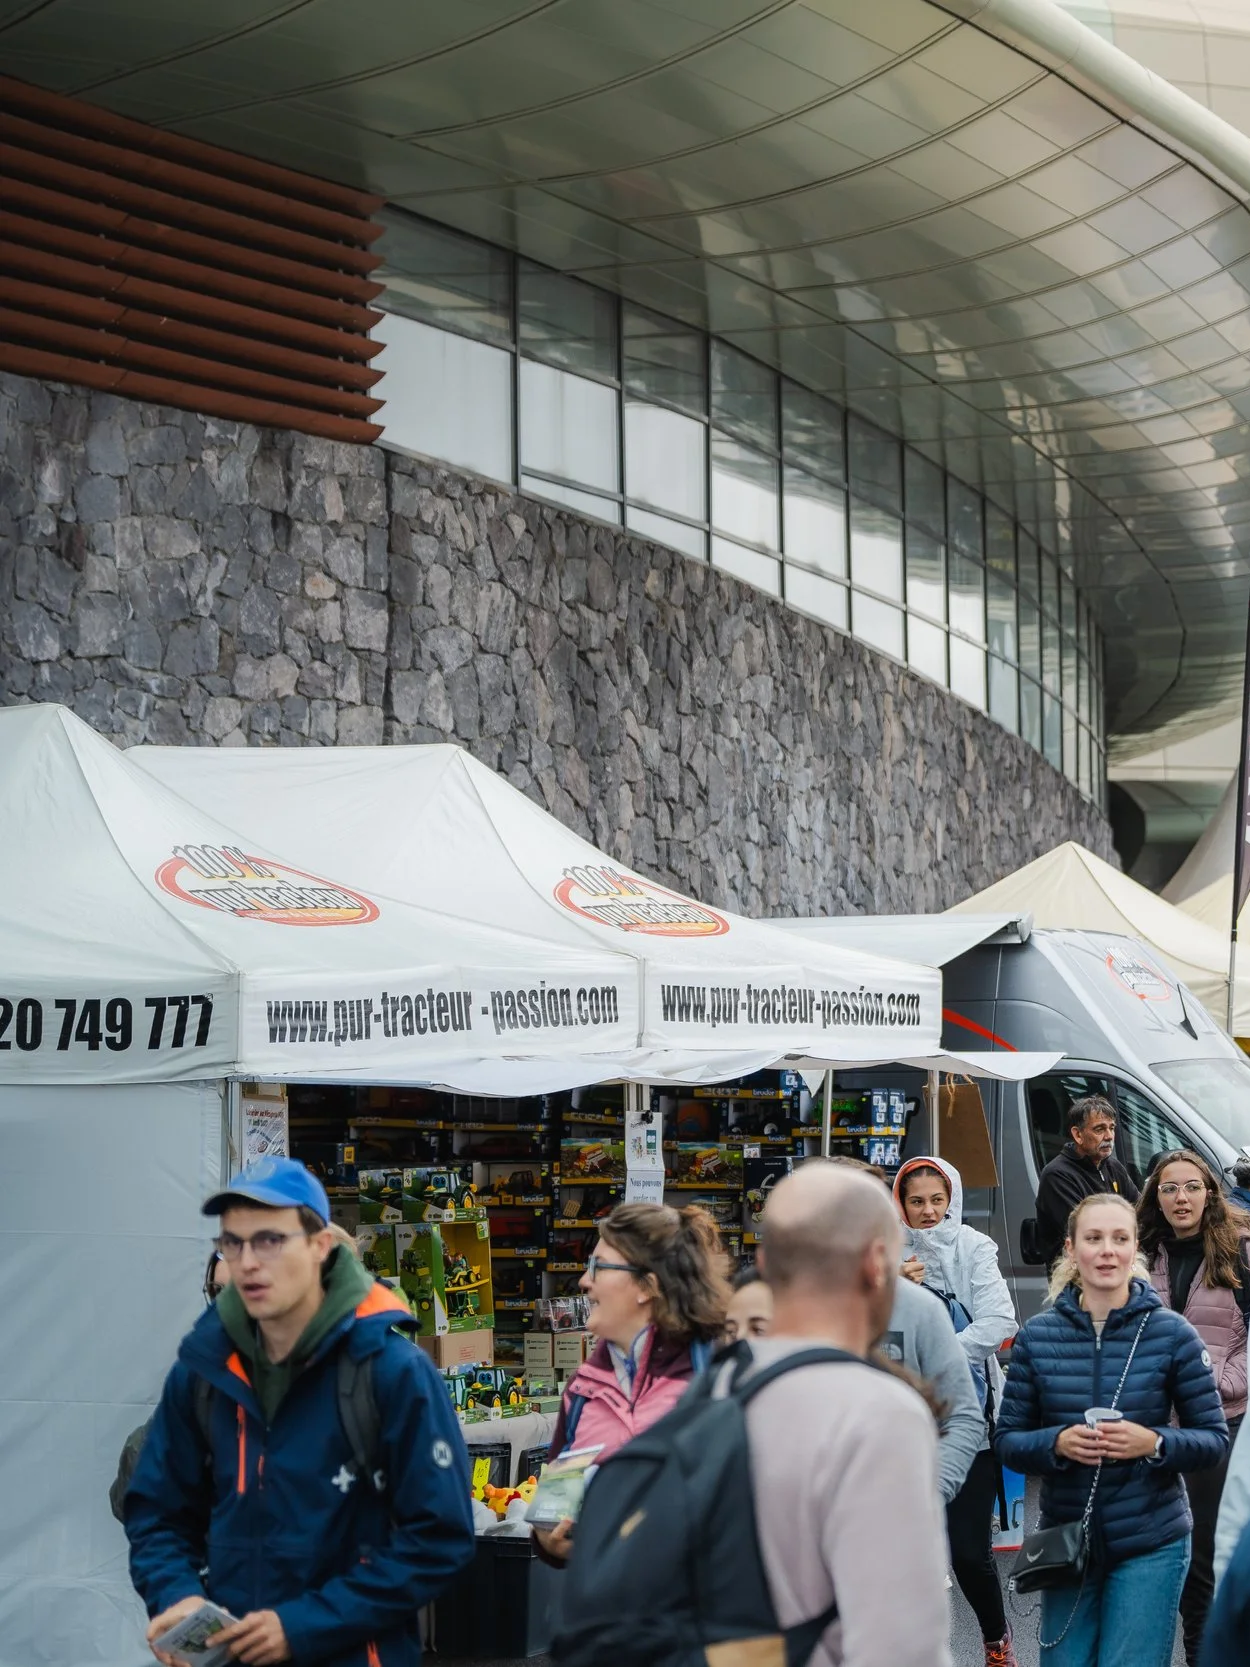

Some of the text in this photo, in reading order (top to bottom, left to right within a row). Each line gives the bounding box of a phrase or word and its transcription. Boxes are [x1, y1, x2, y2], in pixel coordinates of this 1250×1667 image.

[54, 997, 133, 1052] 749
[145, 993, 214, 1050] 777
[661, 984, 921, 1029] www.pur-tracteur-passion.com
